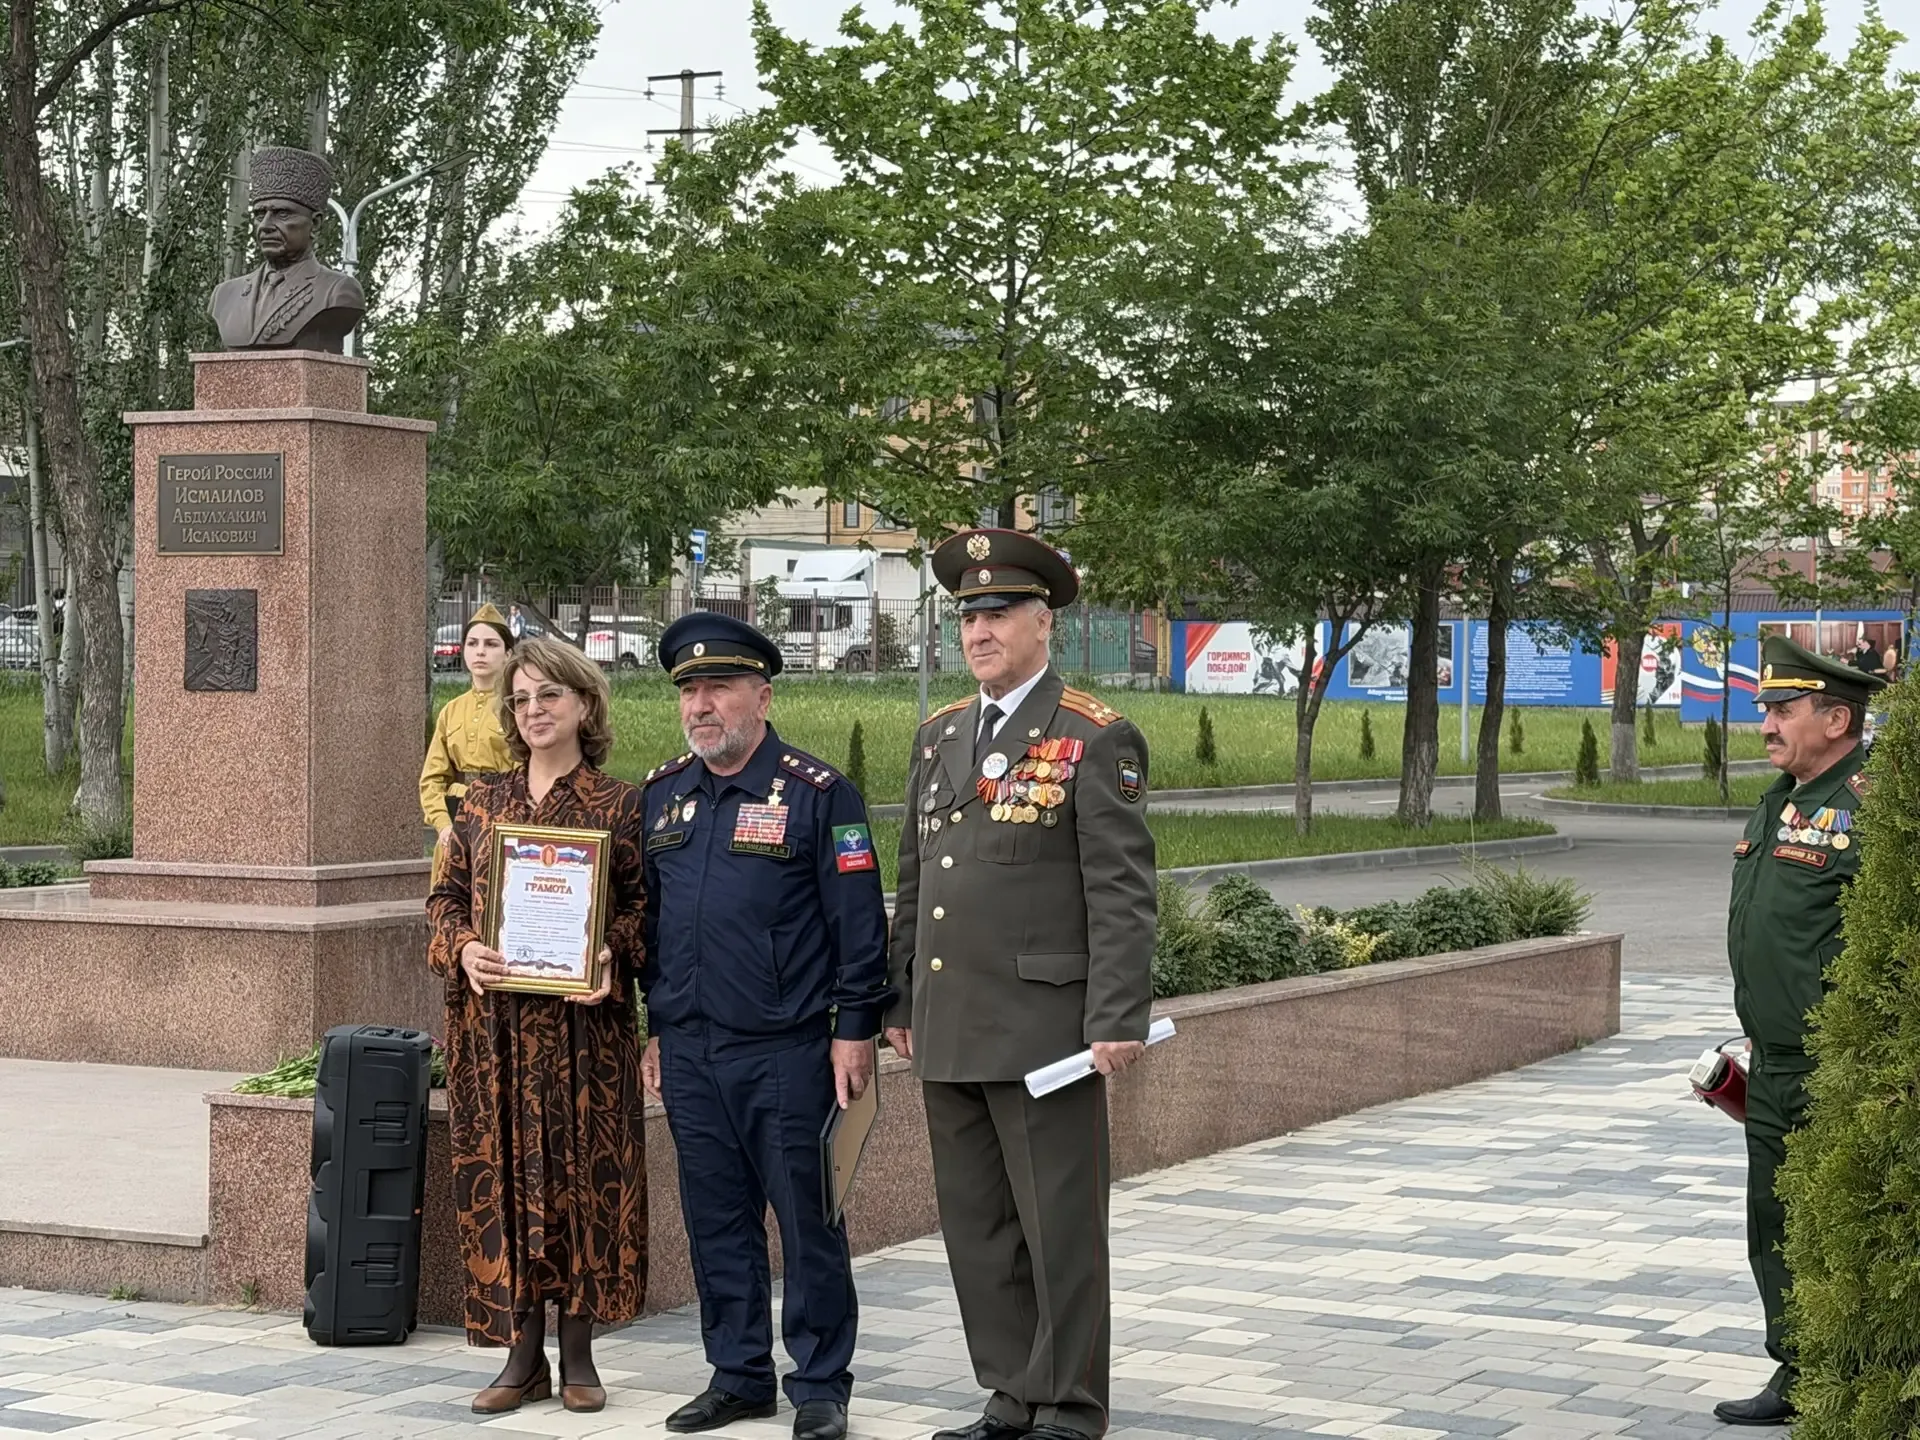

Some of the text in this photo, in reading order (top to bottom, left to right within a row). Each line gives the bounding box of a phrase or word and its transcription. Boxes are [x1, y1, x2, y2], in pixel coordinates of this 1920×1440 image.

[1207, 651, 1251, 662] ГОРДИМСЯ
[1207, 662, 1247, 673] ПОБЕДОЙ!
[524, 882, 573, 895] ГРАМОТА
